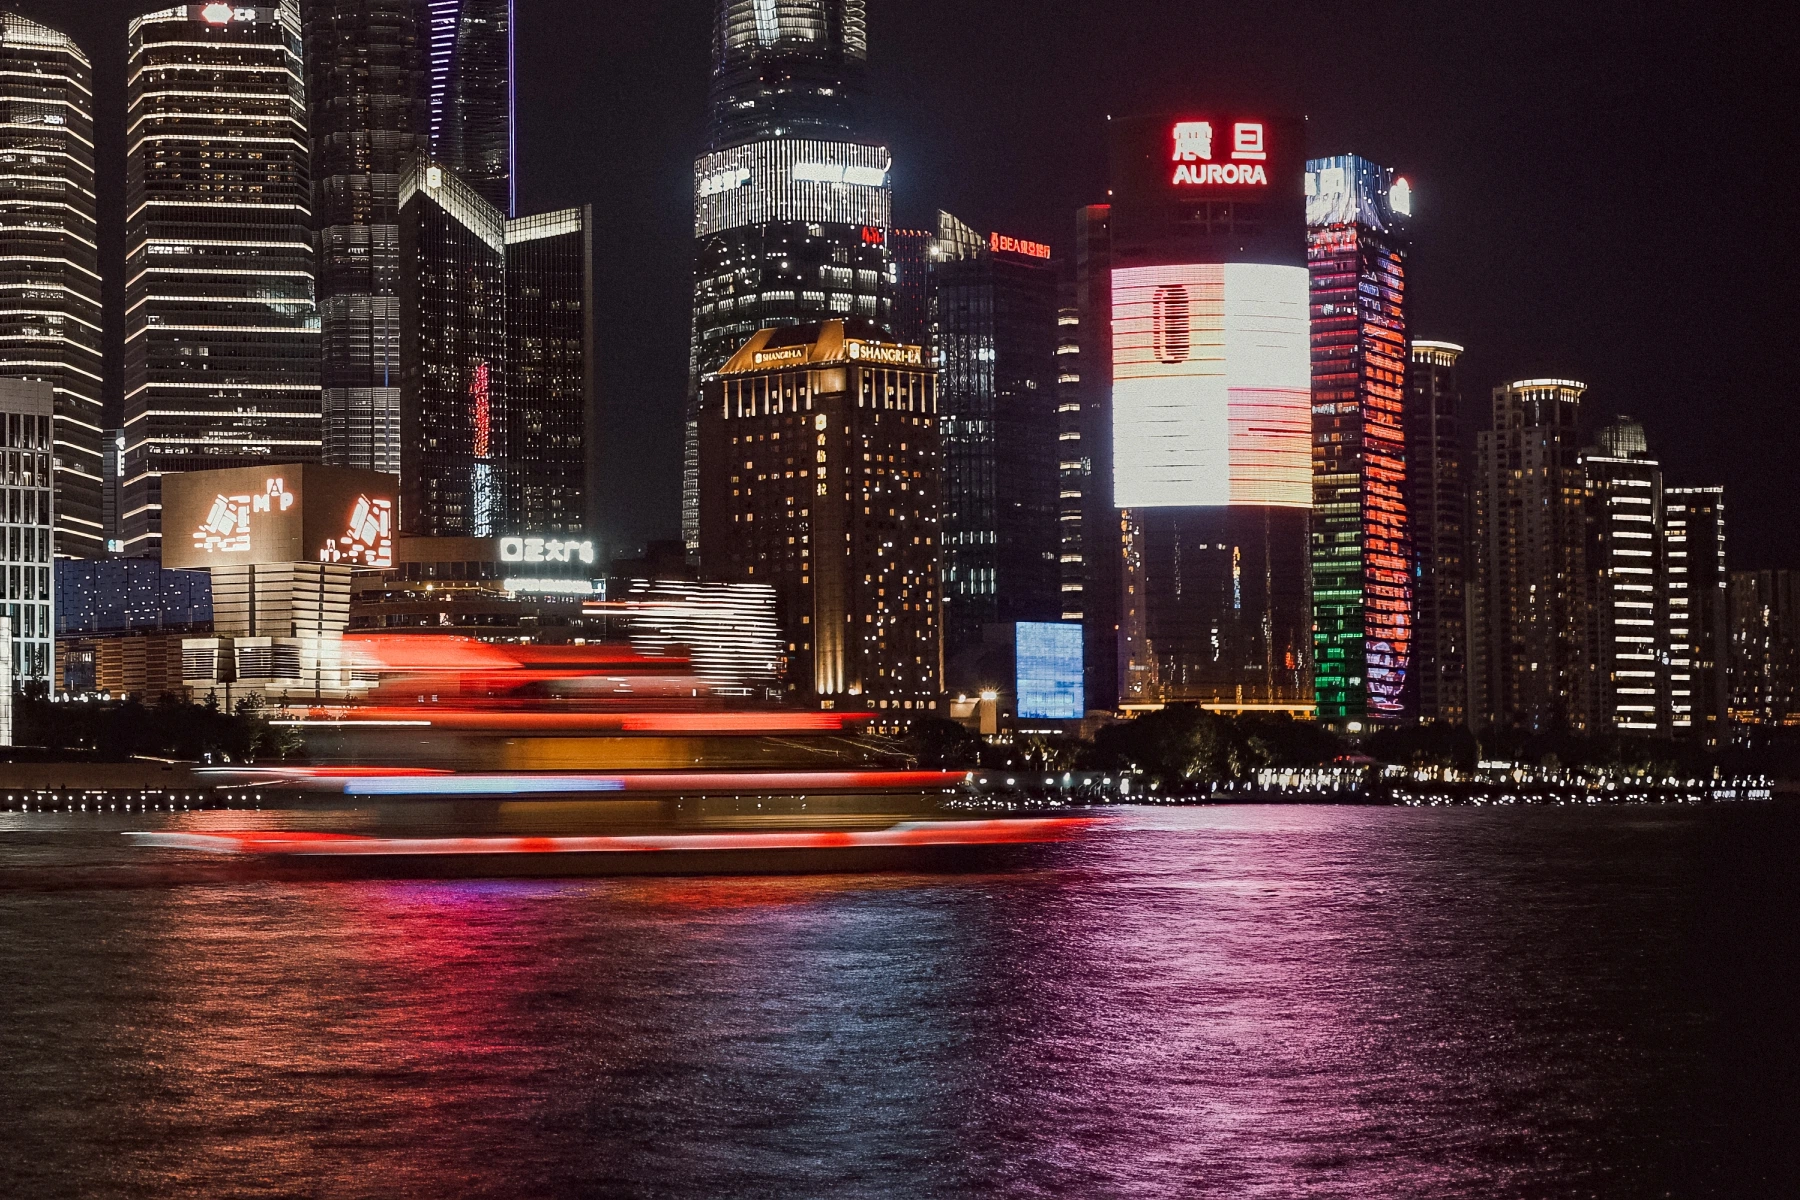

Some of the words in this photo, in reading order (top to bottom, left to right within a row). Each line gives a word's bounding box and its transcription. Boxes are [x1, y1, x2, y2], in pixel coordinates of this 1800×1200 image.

[1172, 121, 1266, 161] 震旦
[1172, 163, 1267, 185] AURORA
[1000, 235, 1020, 253] BEA
[762, 349, 802, 362] SHANGRI-LA
[860, 346, 922, 364] SHANGRI-LA
[253, 477, 294, 513] MAP
